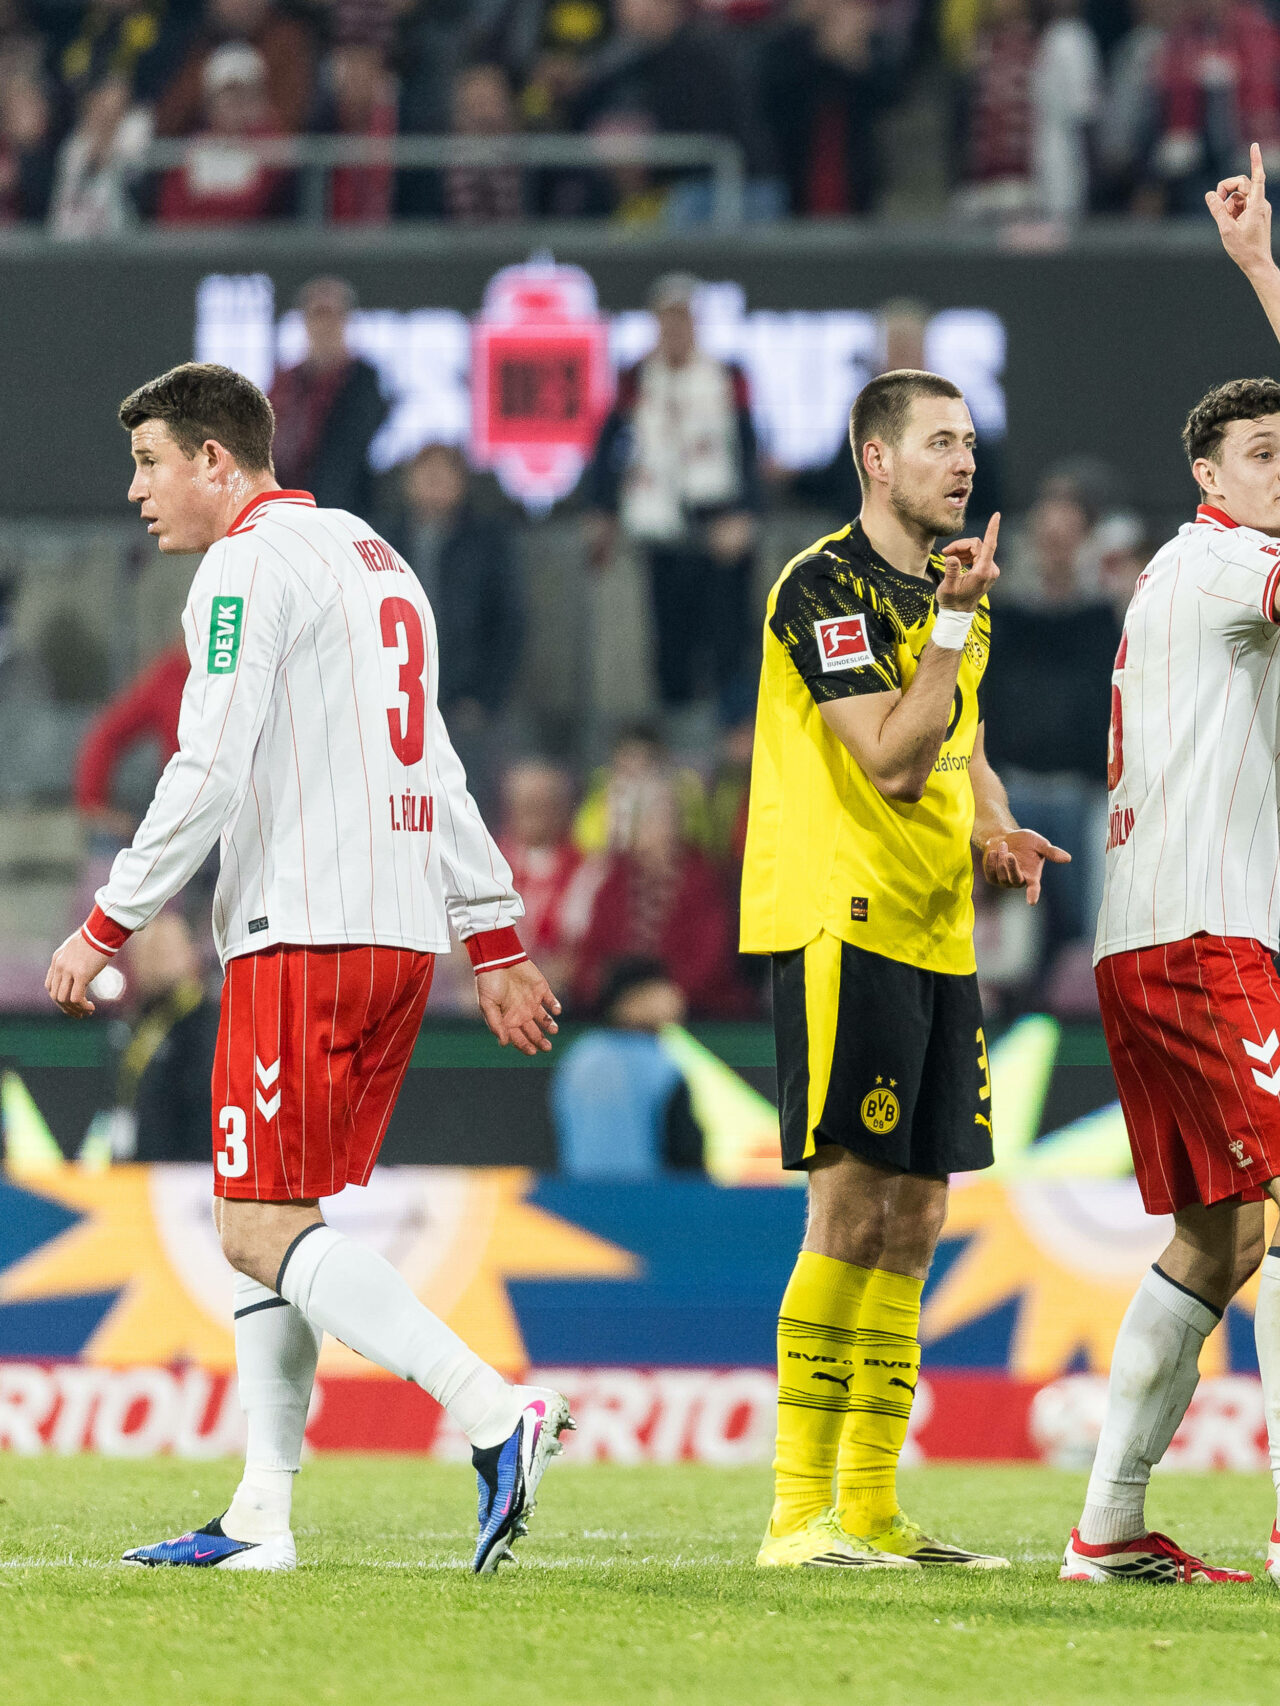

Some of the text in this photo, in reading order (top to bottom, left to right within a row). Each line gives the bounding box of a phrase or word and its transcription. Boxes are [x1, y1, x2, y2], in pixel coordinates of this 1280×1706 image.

[214, 604, 237, 668] DEVK
[826, 654, 870, 668] BUNDESLIGA
[380, 596, 425, 767] 3
[933, 752, 971, 773] dafon
[866, 1092, 895, 1122] BVB
[217, 1105, 248, 1178] 3
[787, 1351, 838, 1363] BVB
[863, 1358, 911, 1369] BVB
